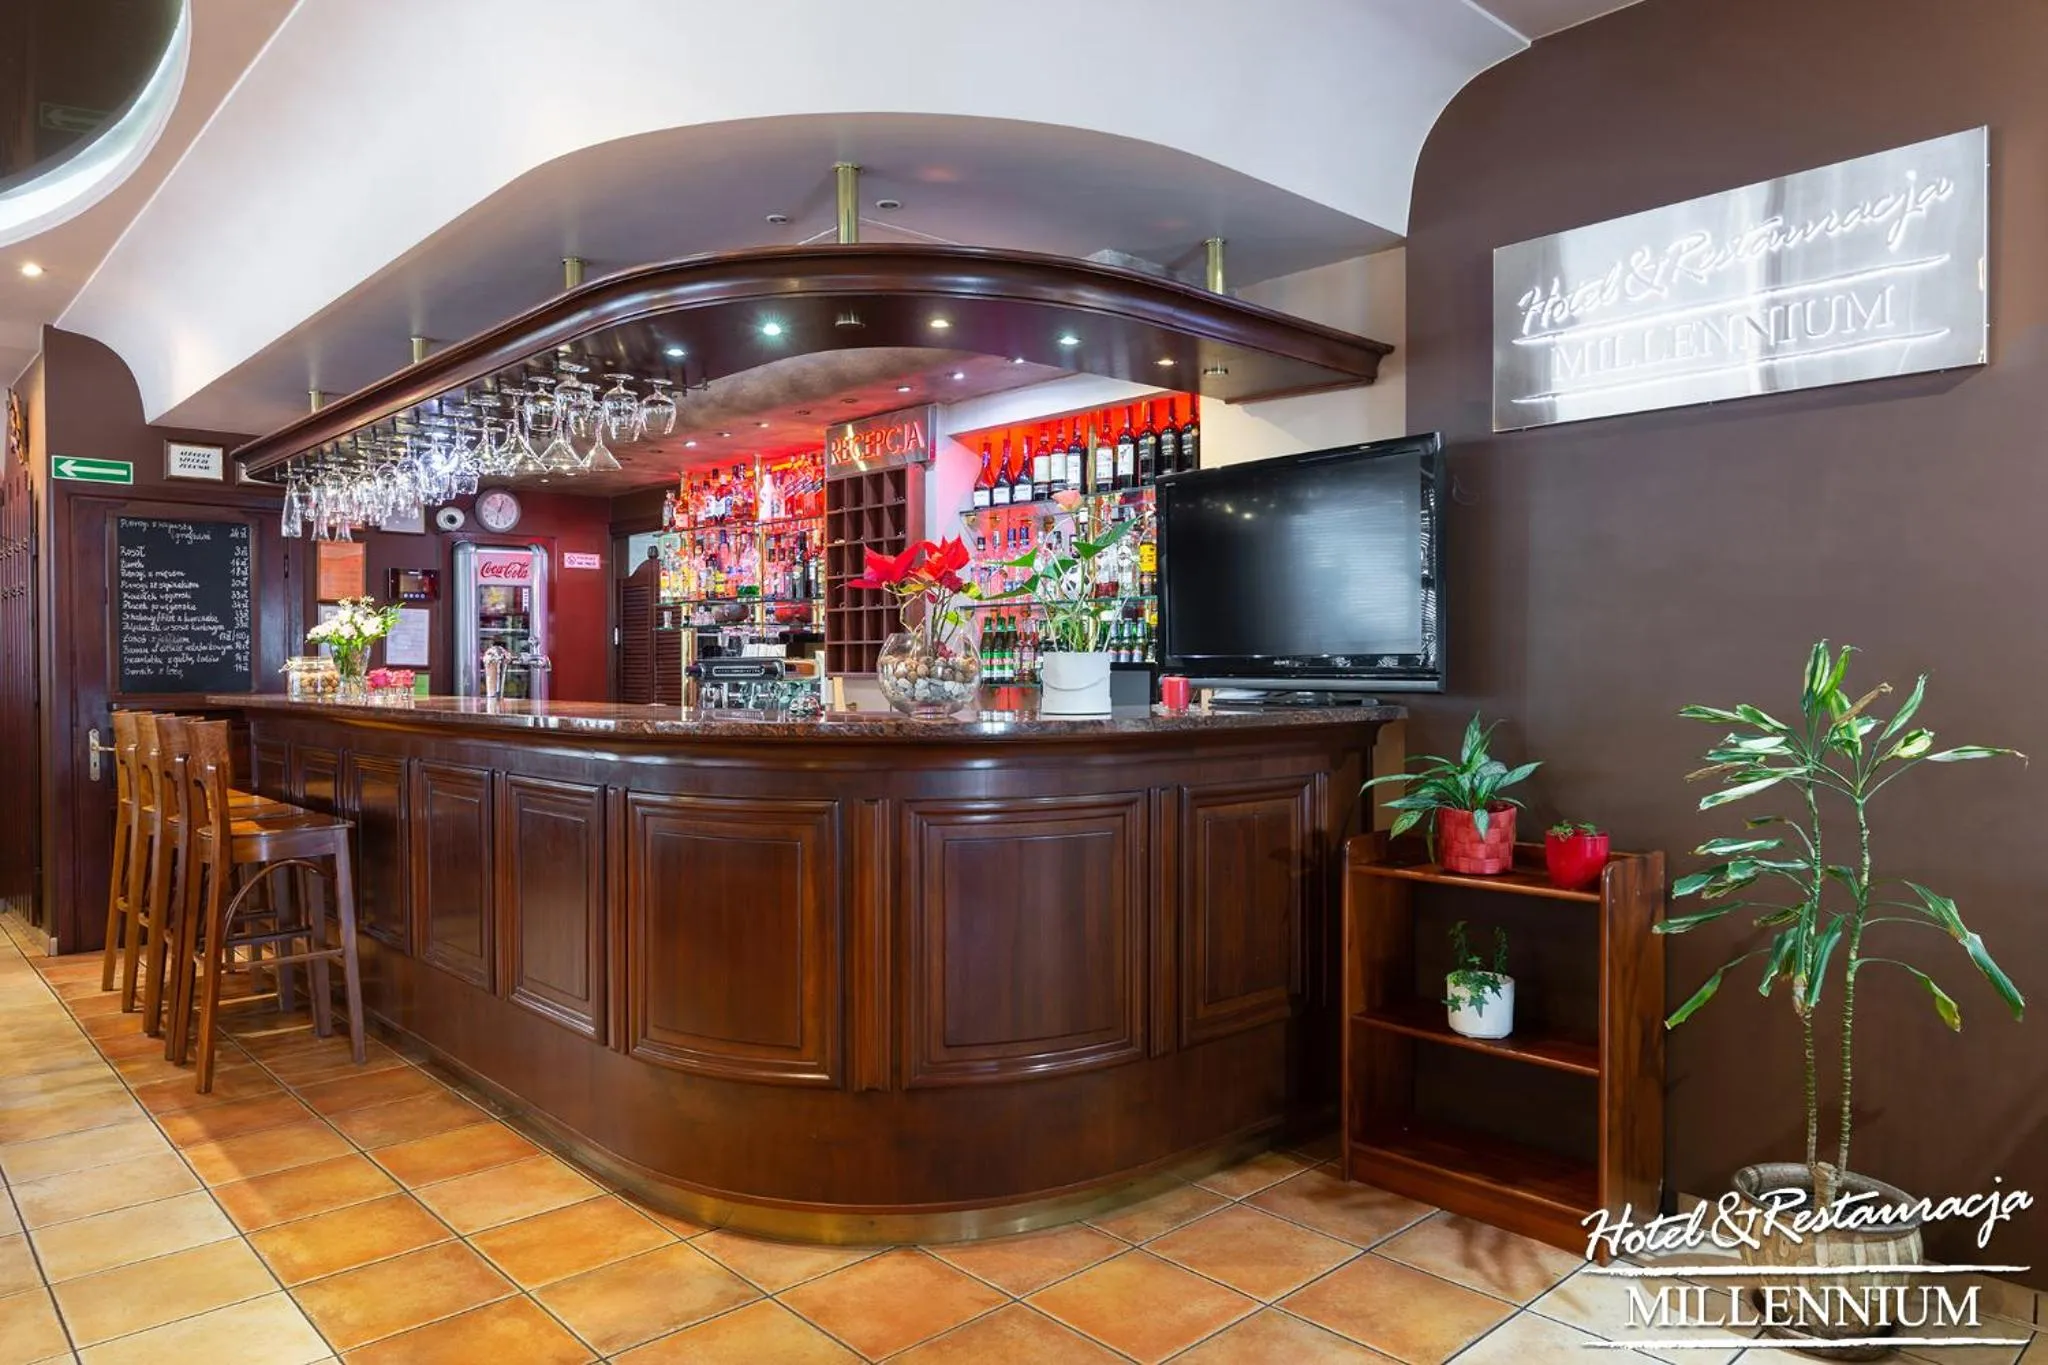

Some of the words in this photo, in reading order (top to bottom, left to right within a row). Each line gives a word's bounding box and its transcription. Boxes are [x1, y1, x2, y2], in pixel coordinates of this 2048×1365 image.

[1516, 263, 1620, 334] Hotel
[1623, 245, 1670, 302] &
[1665, 170, 1955, 284] Restauracja
[1549, 284, 1898, 384] MILLENNIUM
[830, 421, 926, 466] RECEPCJA
